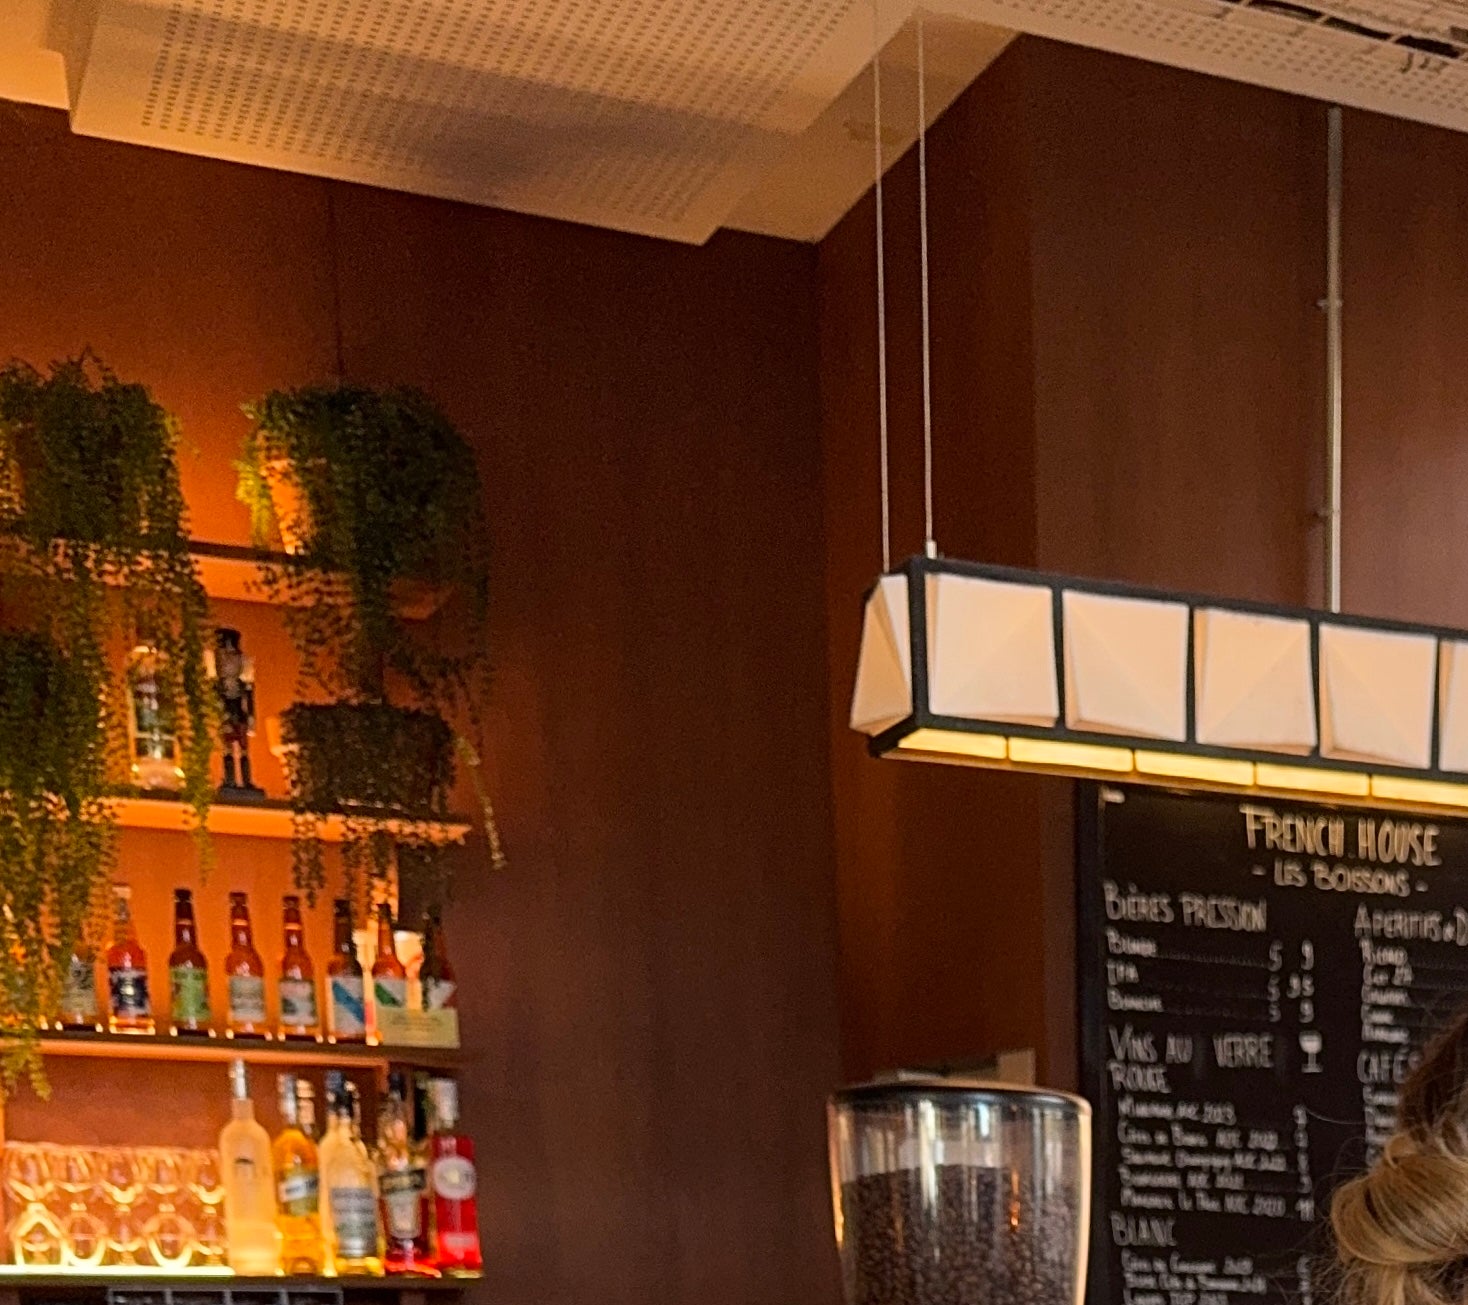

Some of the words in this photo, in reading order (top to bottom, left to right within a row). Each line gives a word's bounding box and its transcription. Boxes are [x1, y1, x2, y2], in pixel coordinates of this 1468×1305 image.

[1239, 803, 1345, 858] FRENCH
[1358, 815, 1443, 867] HOUSE
[1274, 856, 1308, 888] LES
[1310, 858, 1411, 898] BOISSONS
[1178, 890, 1268, 933] PRESSION
[1212, 1032, 1274, 1068] VERRE
